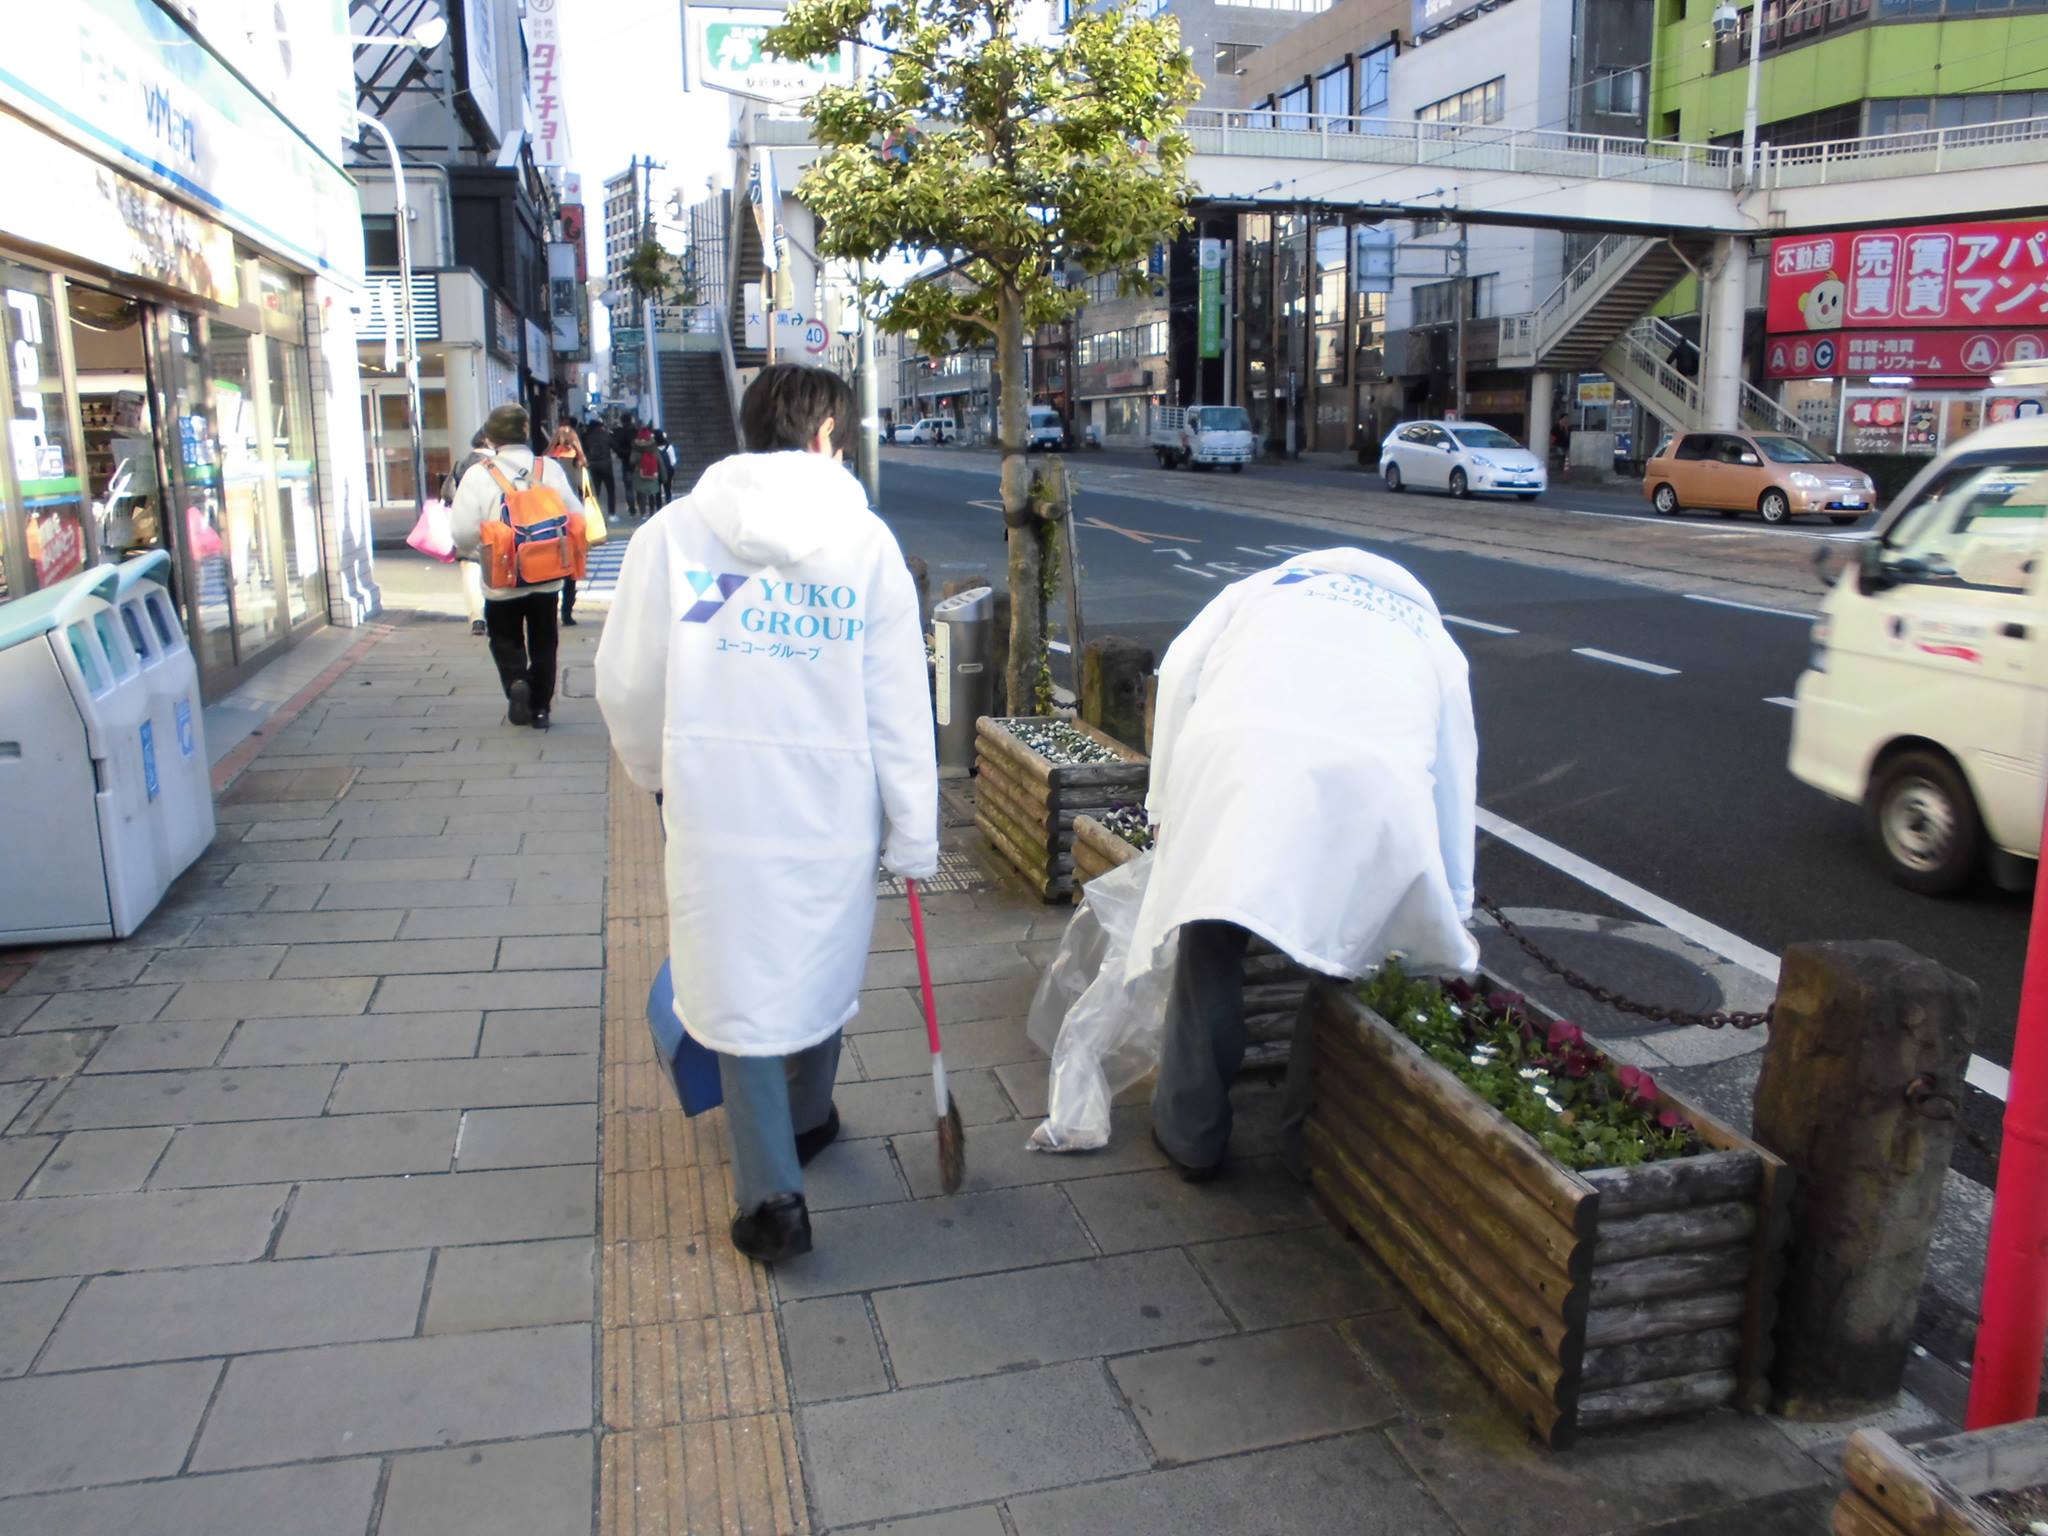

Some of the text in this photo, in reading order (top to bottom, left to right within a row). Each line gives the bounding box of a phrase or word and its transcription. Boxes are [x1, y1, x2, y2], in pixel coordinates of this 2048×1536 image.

[532, 43, 558, 161] タナチョー
[1778, 243, 1831, 273] 不動産
[1905, 237, 1948, 313] 賃貸
[1854, 239, 1895, 314] 売買
[806, 328, 823, 343] 40
[758, 577, 856, 610] YUKO
[740, 607, 865, 642] GROUP
[715, 637, 822, 662] ユーコーグループ
